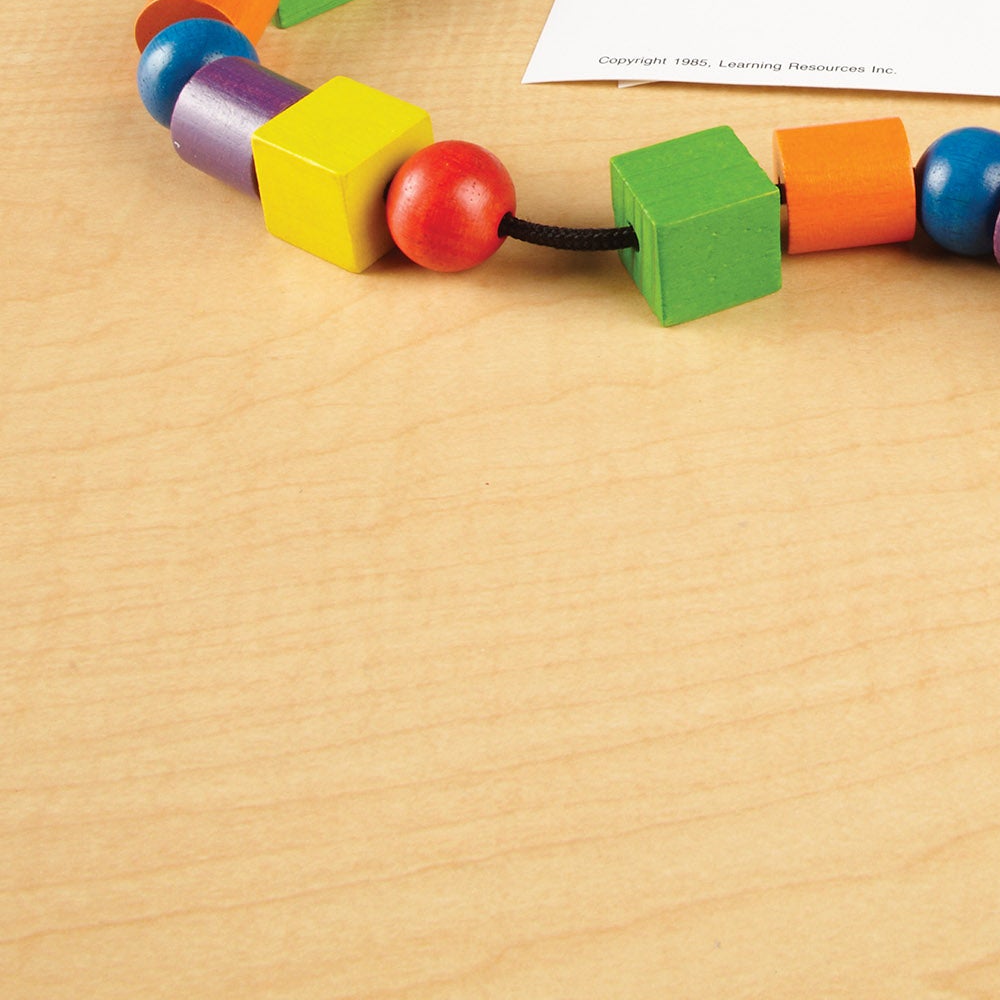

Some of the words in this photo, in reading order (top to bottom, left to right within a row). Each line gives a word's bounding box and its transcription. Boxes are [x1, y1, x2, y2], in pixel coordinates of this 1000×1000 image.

[598, 56, 667, 66] Copyright
[675, 57, 711, 67] 1985,
[718, 59, 782, 72] Learning
[788, 62, 865, 73] Resources
[871, 65, 897, 75] Inc.
